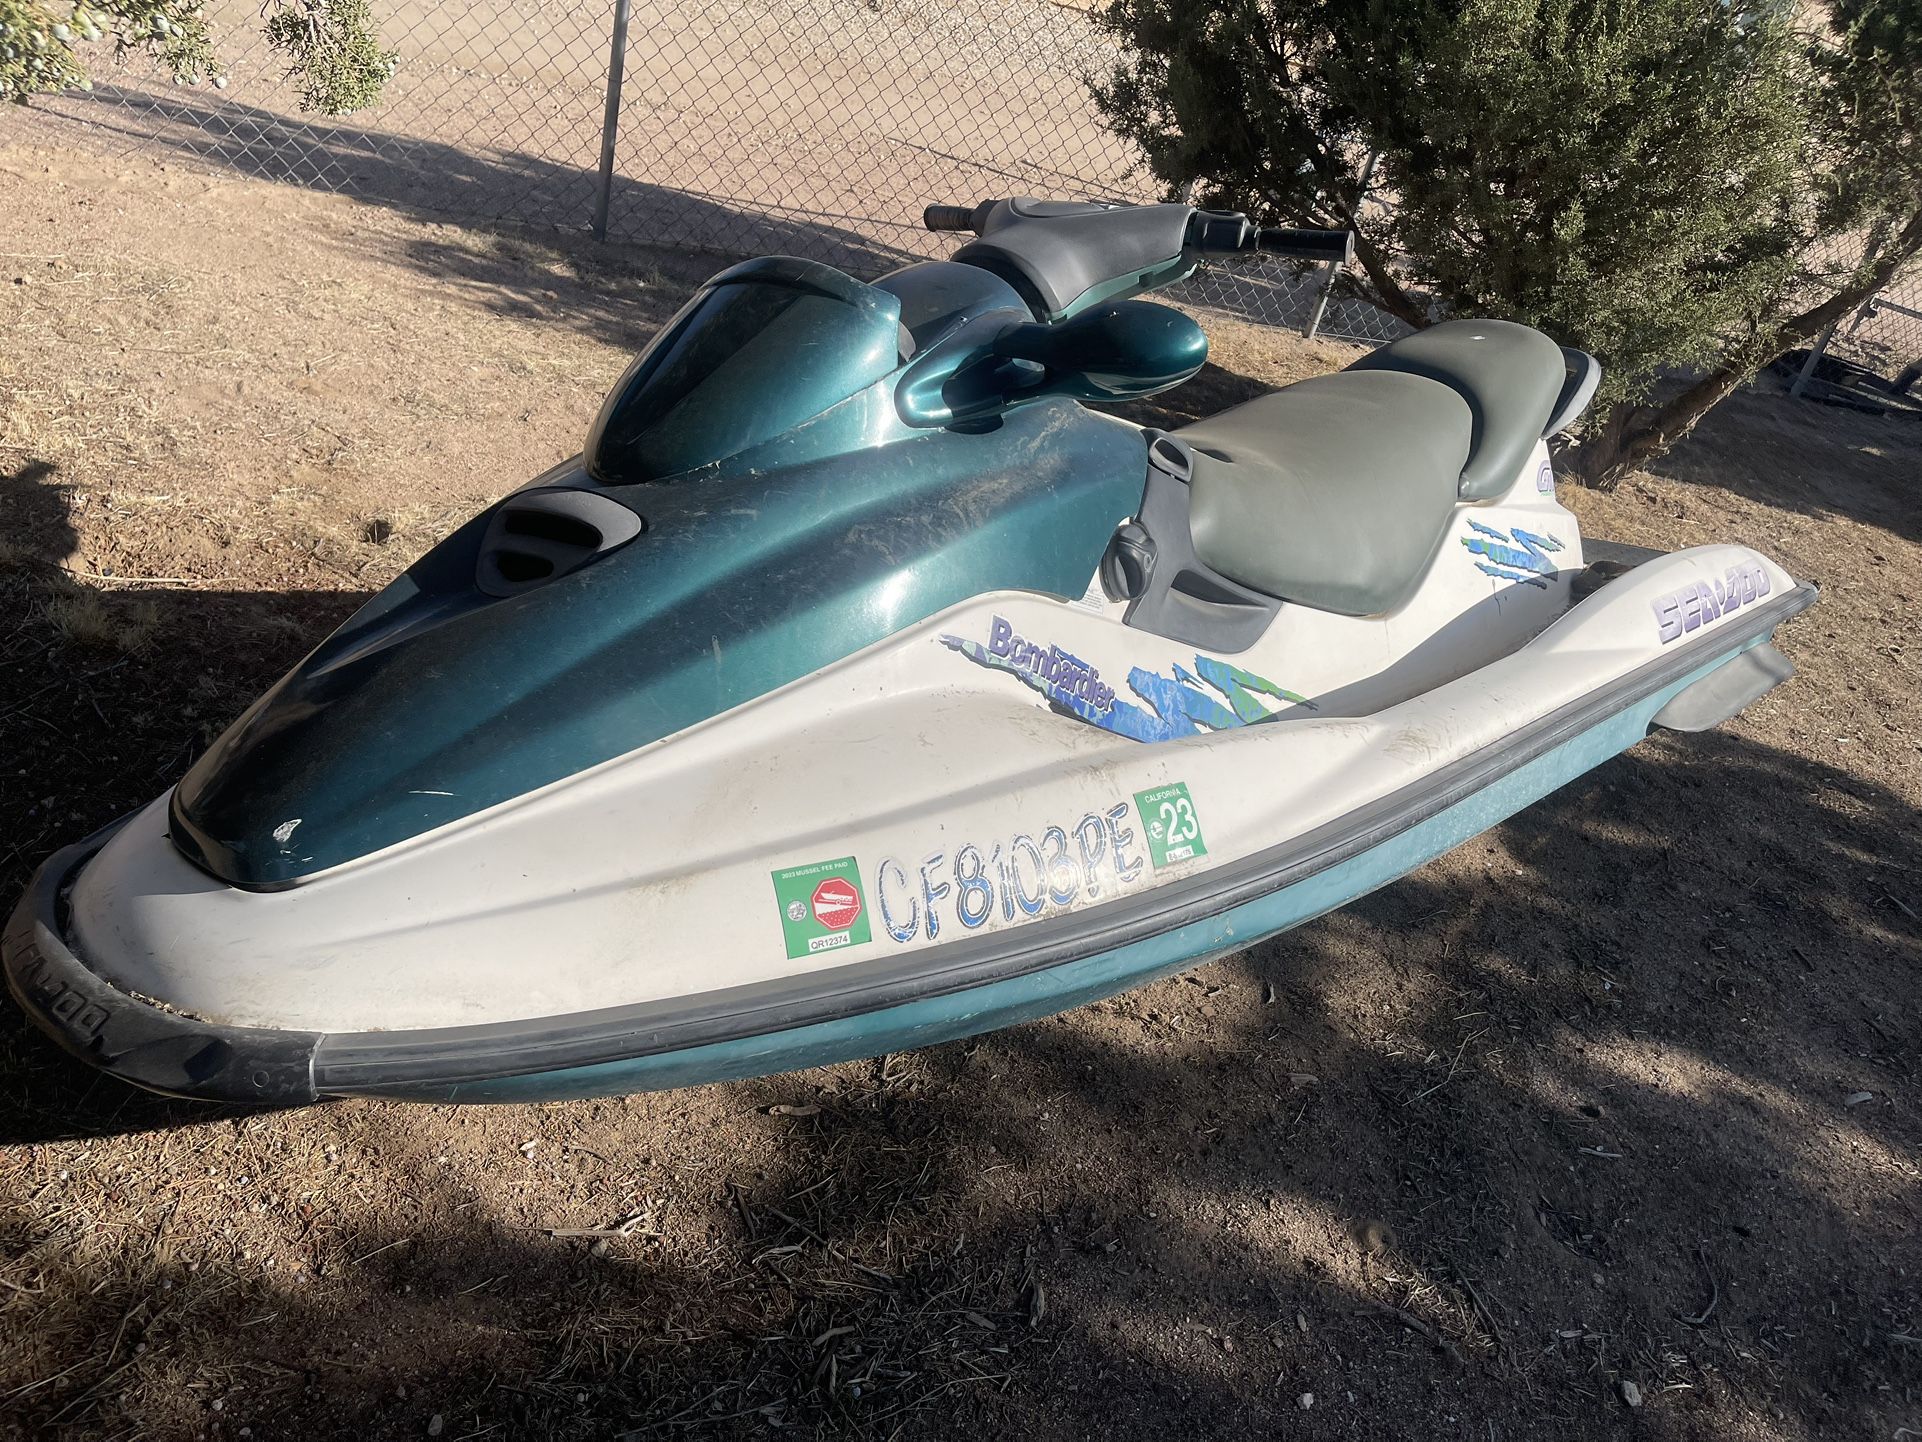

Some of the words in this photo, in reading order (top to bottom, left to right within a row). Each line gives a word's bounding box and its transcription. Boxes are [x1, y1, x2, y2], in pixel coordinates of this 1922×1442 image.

[988, 614, 1116, 712] Bombardier
[1144, 788, 1181, 803] CALIFORNIA
[1160, 797, 1198, 846] 23
[796, 867, 820, 876] MUSSEL
[834, 861, 848, 869] PAID
[875, 802, 1144, 943] CF8103PE
[811, 935, 848, 949] QR12374
